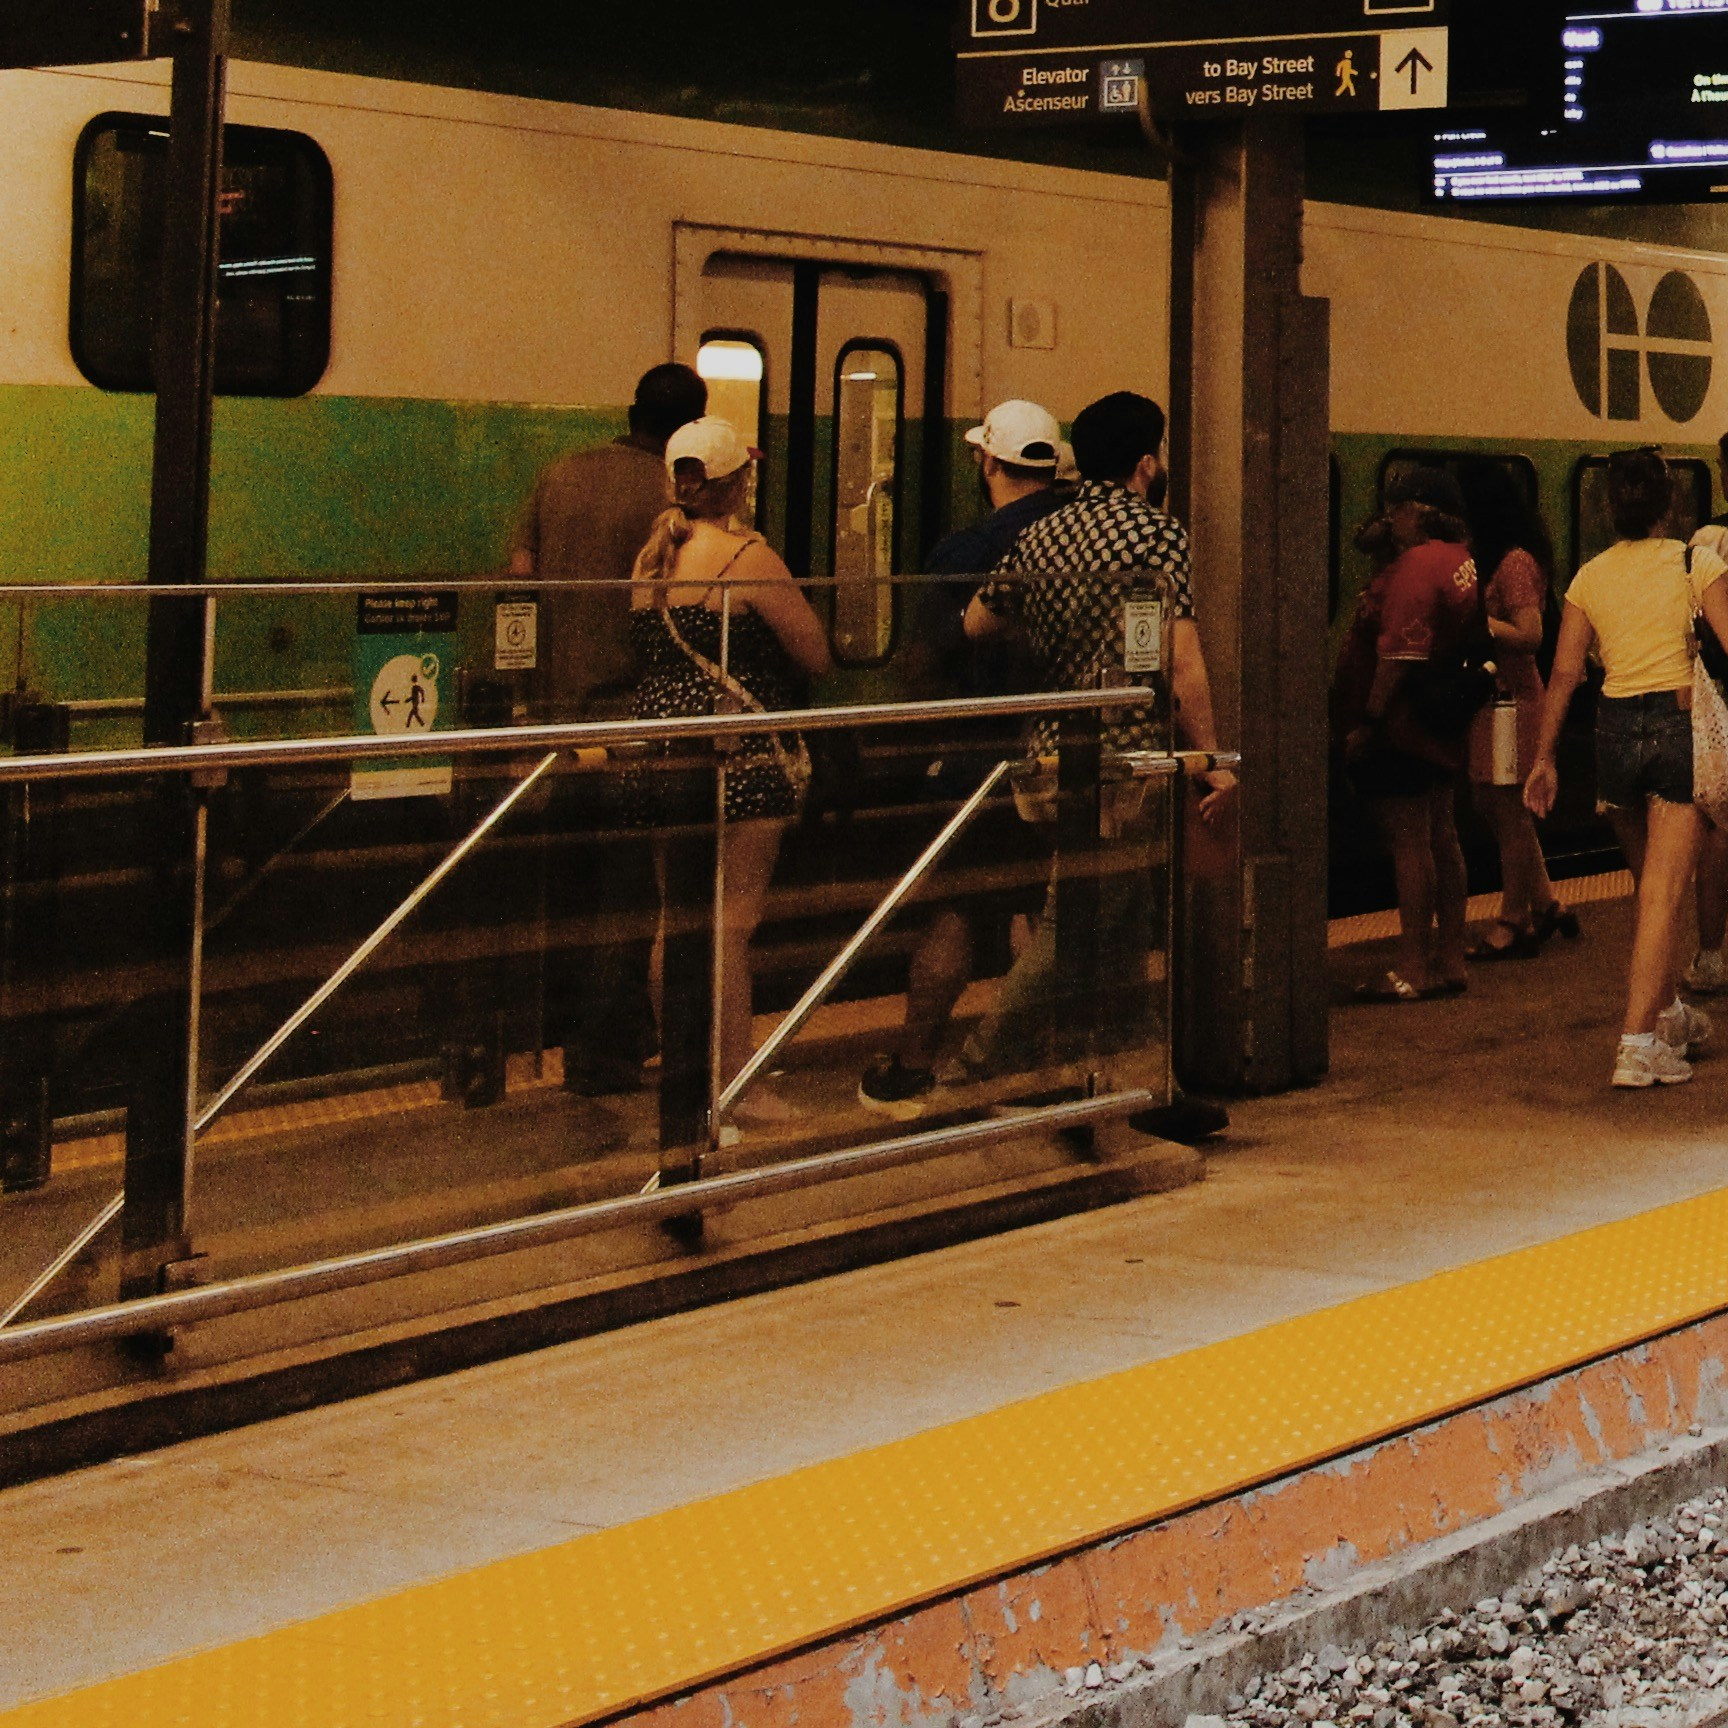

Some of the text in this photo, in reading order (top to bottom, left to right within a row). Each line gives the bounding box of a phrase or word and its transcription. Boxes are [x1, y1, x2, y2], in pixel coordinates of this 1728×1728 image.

[1021, 66, 1090, 86] Elevator
[1202, 54, 1315, 80] to Bay Street
[1003, 93, 1090, 113] Ascenseur
[1185, 82, 1314, 107] vers Bay Street
